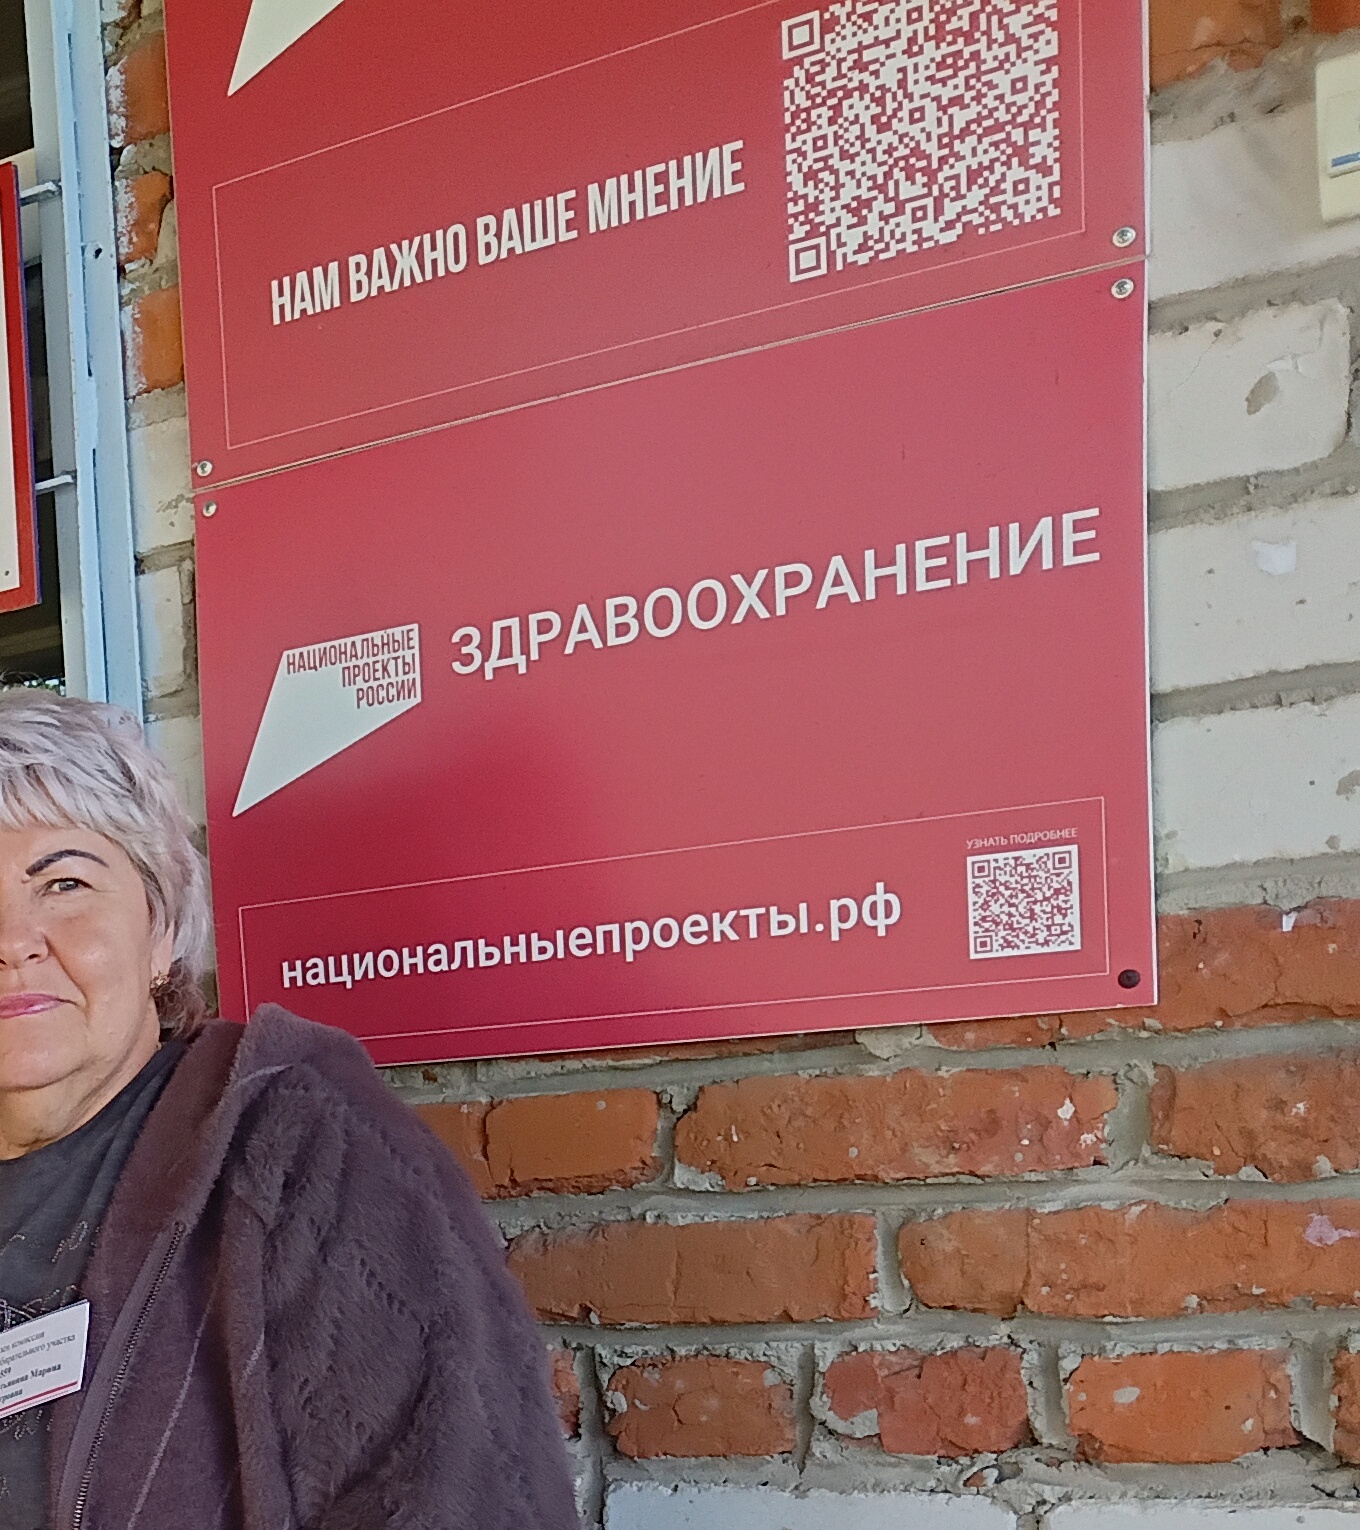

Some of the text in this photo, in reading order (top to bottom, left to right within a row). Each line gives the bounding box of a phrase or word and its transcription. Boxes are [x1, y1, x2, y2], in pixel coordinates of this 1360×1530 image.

[269, 139, 747, 326] НАМ ВАЖНО ВАШЕ МНЕНИЕ
[450, 506, 1102, 681] ЗДРАВООХРАНЕНИЕ
[286, 628, 416, 675] НАЦИОНАЛЬНЫЕ
[342, 653, 416, 688] ПРОЕКТЫ
[356, 678, 417, 709] РОССИИ
[966, 827, 1078, 849] УЗНАТЬ ПОДРОБНЕЕ
[280, 882, 903, 990] национальныепроекты.рф
